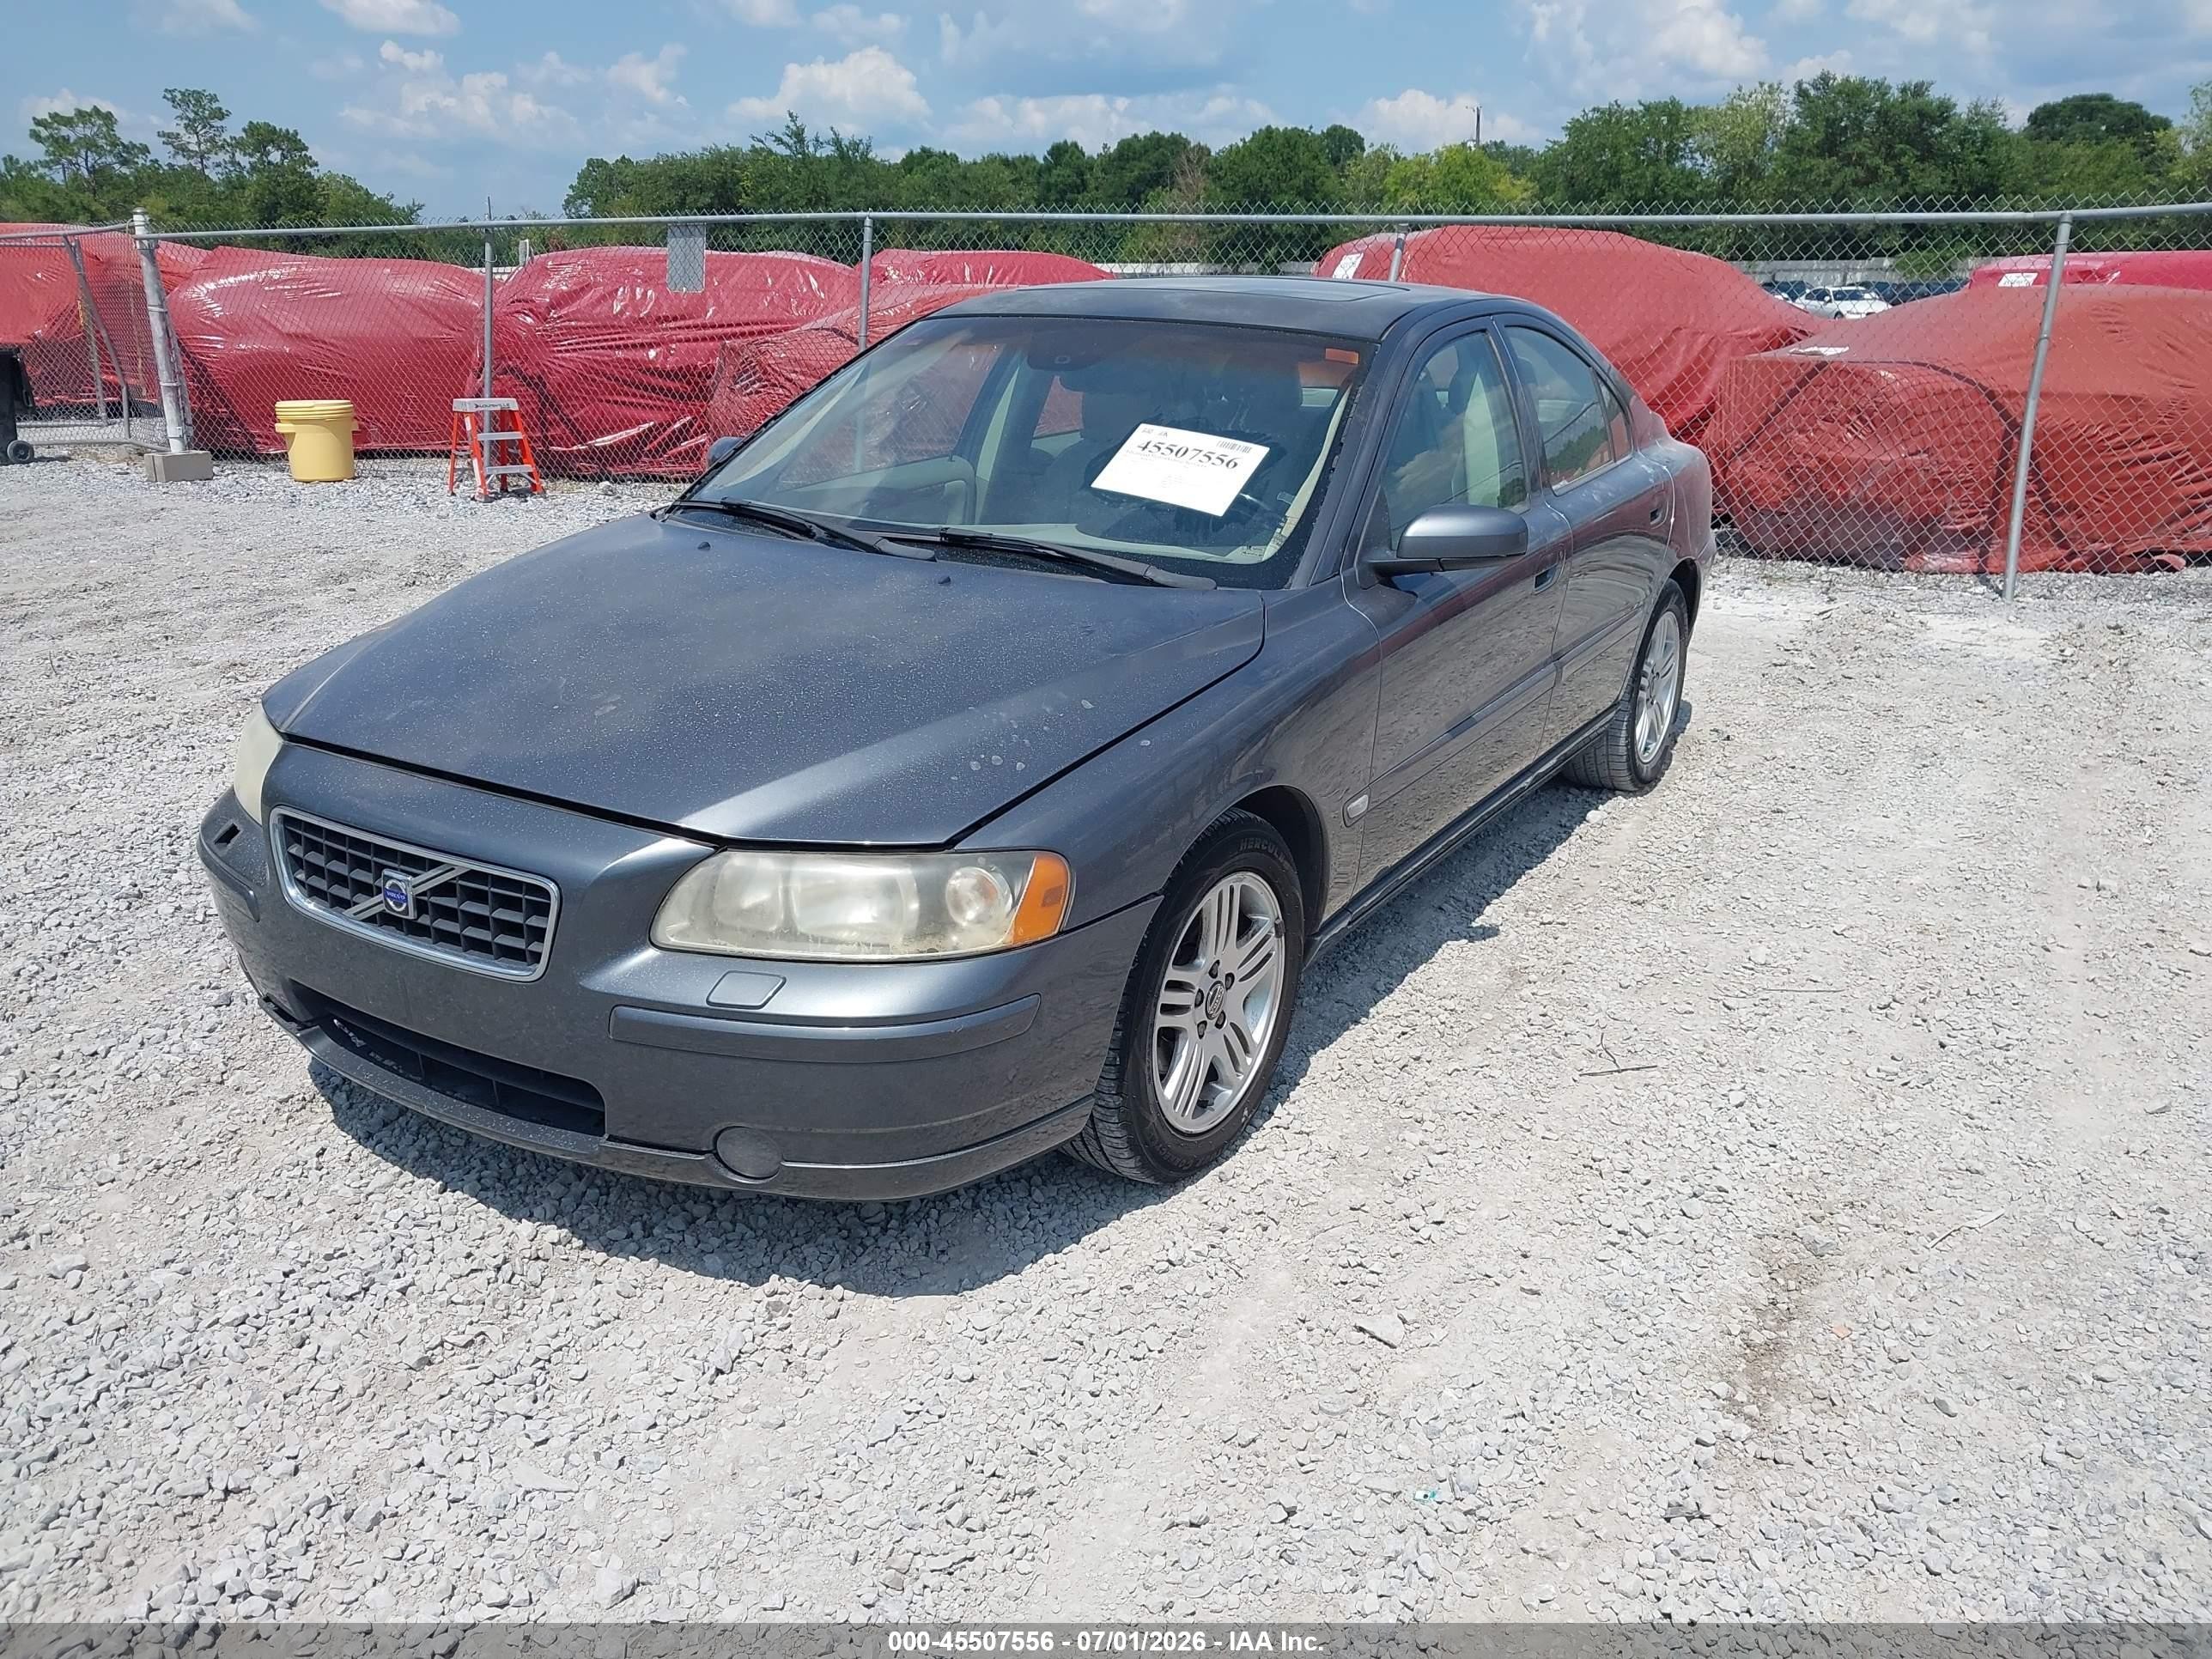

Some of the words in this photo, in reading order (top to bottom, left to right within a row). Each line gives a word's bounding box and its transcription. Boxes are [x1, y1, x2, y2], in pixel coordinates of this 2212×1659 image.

[1136, 440, 1243, 470] 45507556
[1238, 837, 1290, 871] HERCUL
[386, 890, 406, 900] VOLVO
